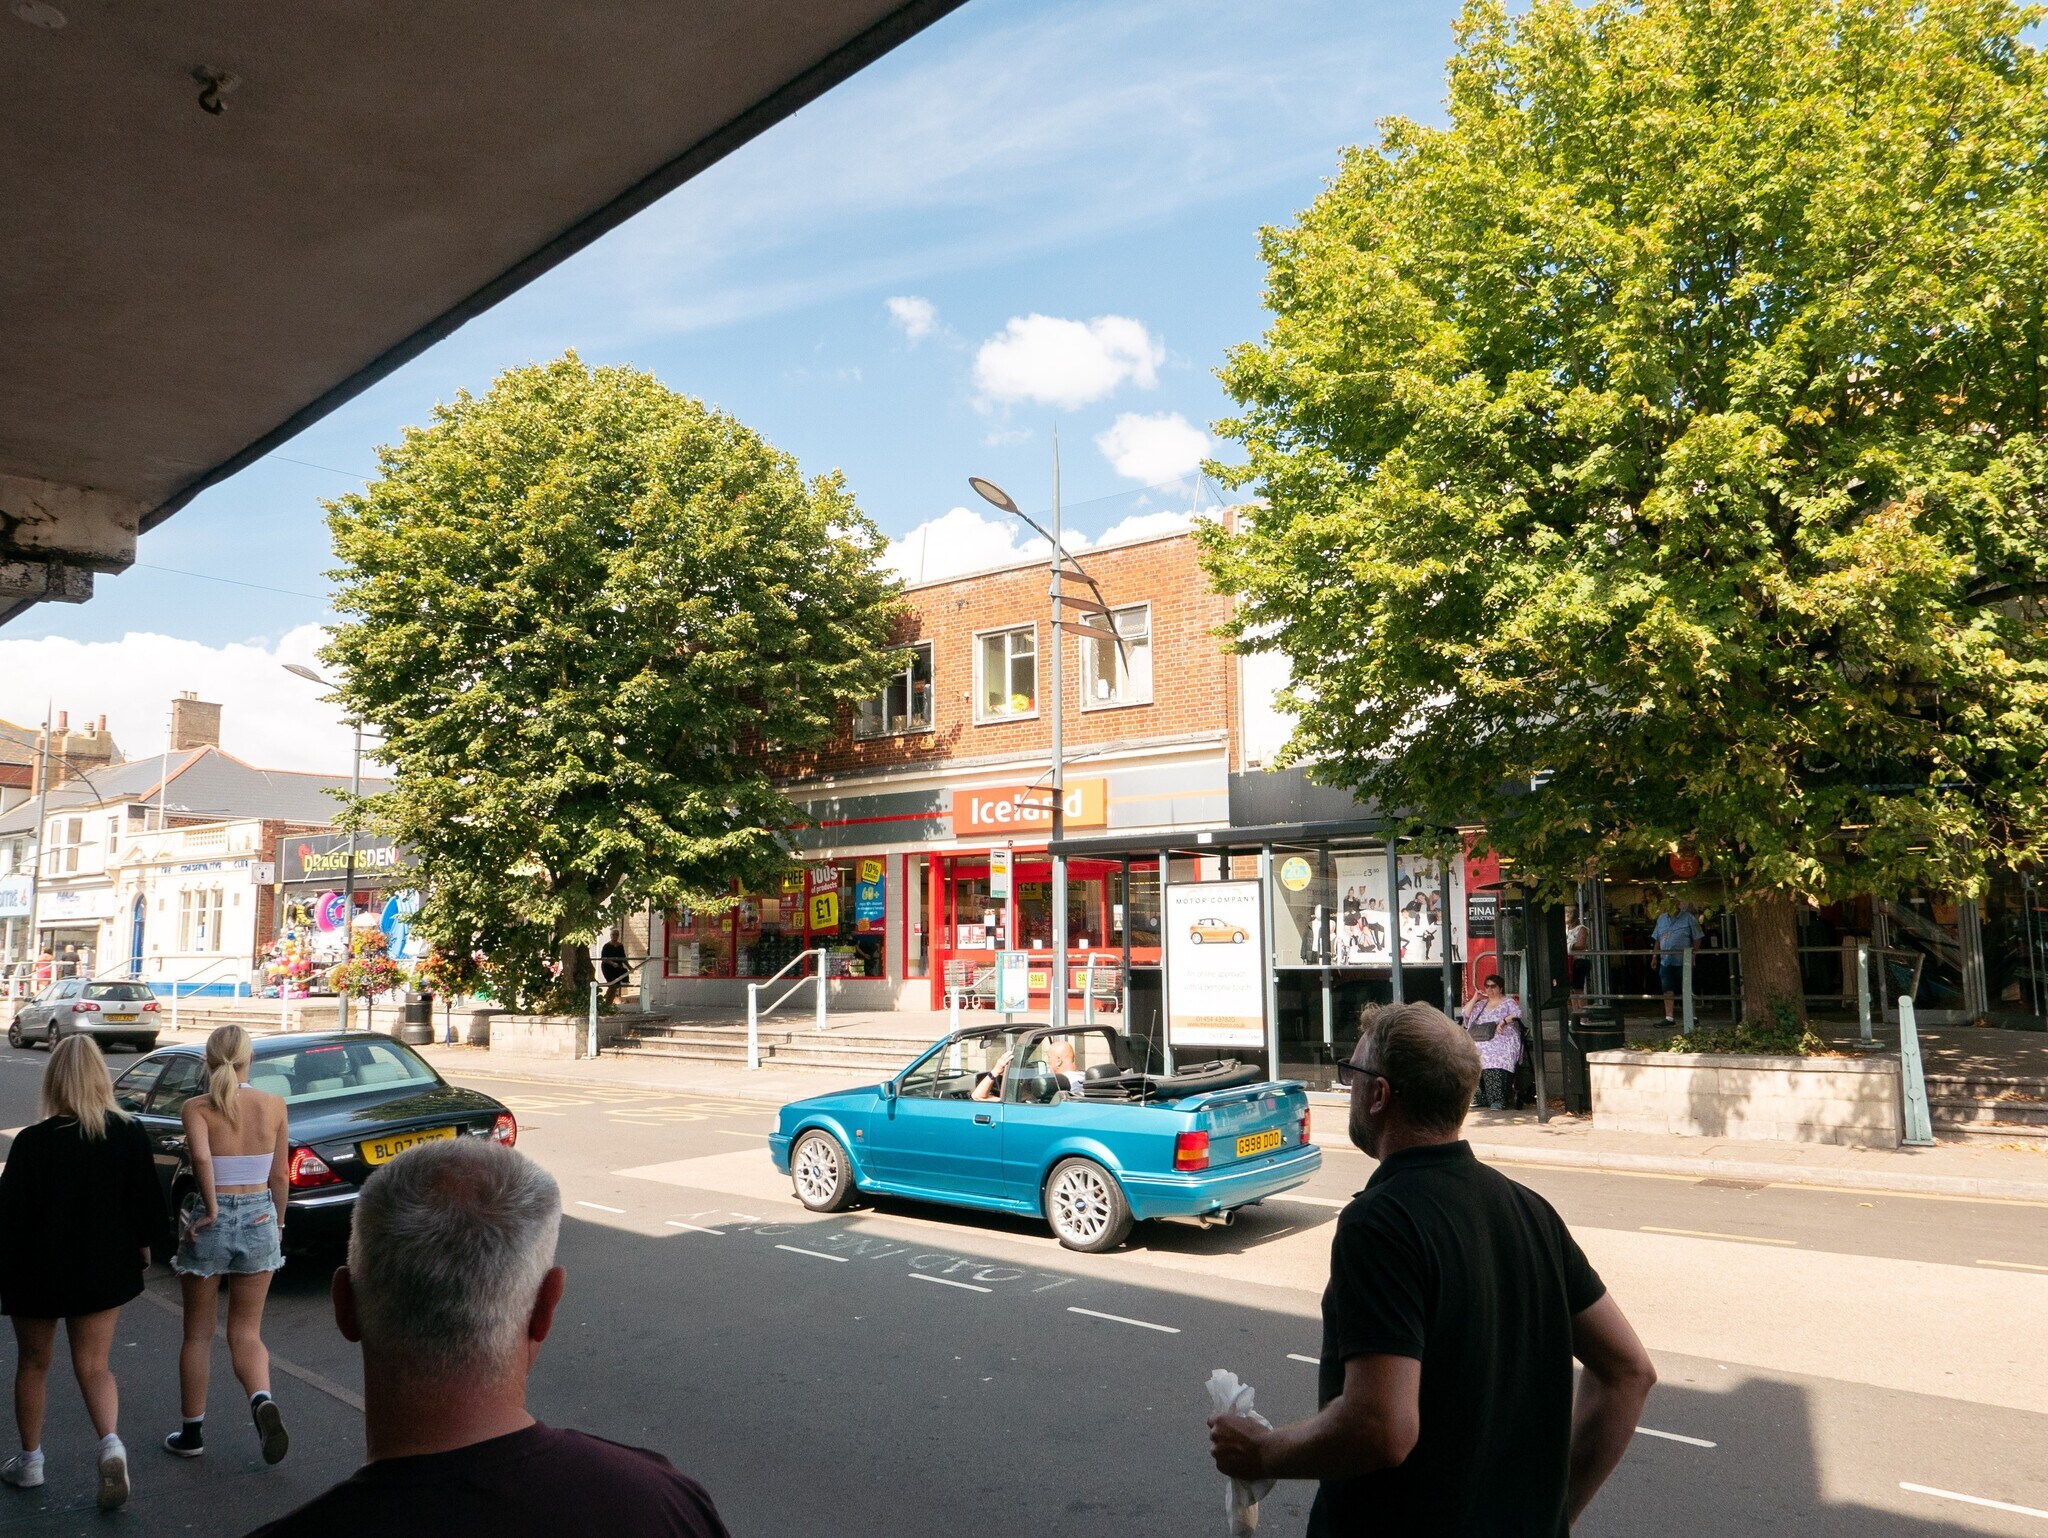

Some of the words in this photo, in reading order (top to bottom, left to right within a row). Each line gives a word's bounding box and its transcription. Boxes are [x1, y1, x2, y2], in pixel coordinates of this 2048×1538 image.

[816, 897, 831, 920] £1
[1176, 897, 1207, 905] MOTOR
[1210, 896, 1256, 904] COMPANY
[1239, 1136, 1261, 1153] G998
